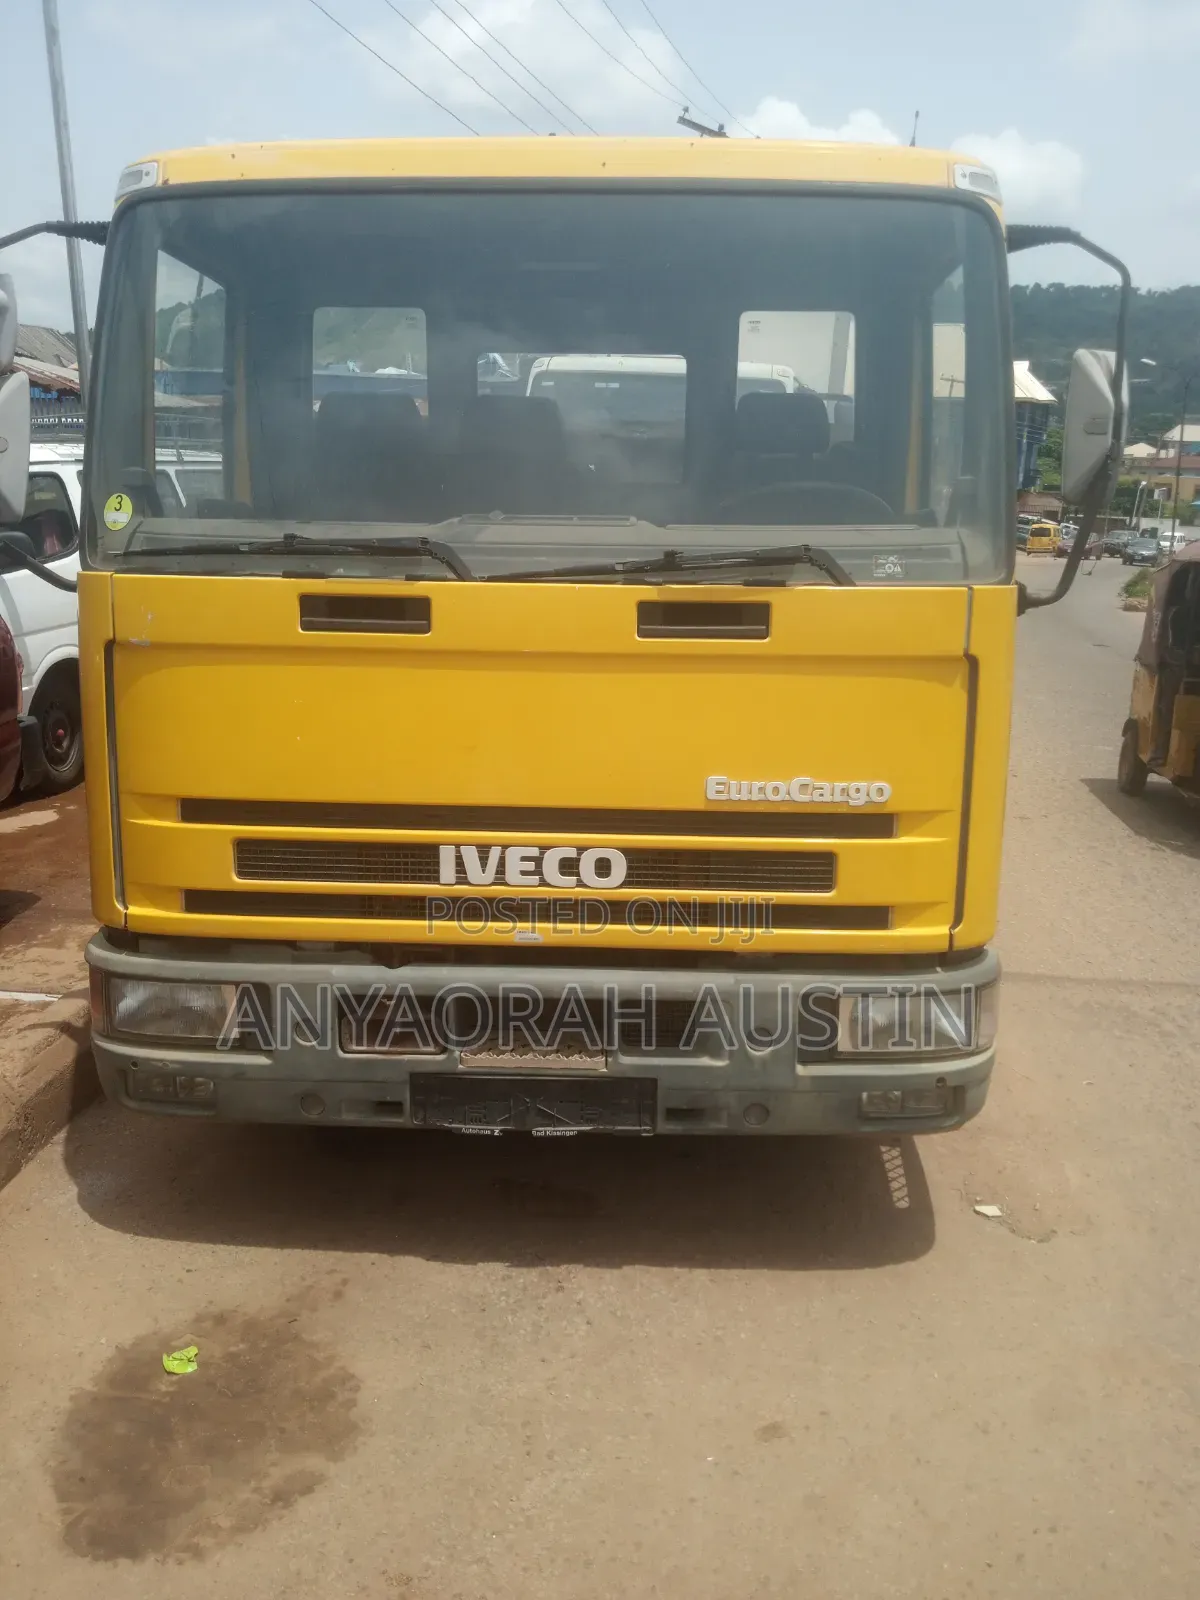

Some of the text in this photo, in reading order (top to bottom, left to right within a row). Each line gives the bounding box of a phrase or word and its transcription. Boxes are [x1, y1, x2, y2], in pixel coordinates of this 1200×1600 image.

[114, 494, 124, 512] 3
[705, 776, 892, 806] EuroCargo
[438, 844, 628, 889] IVECO
[461, 1127, 492, 1136] Autohaus
